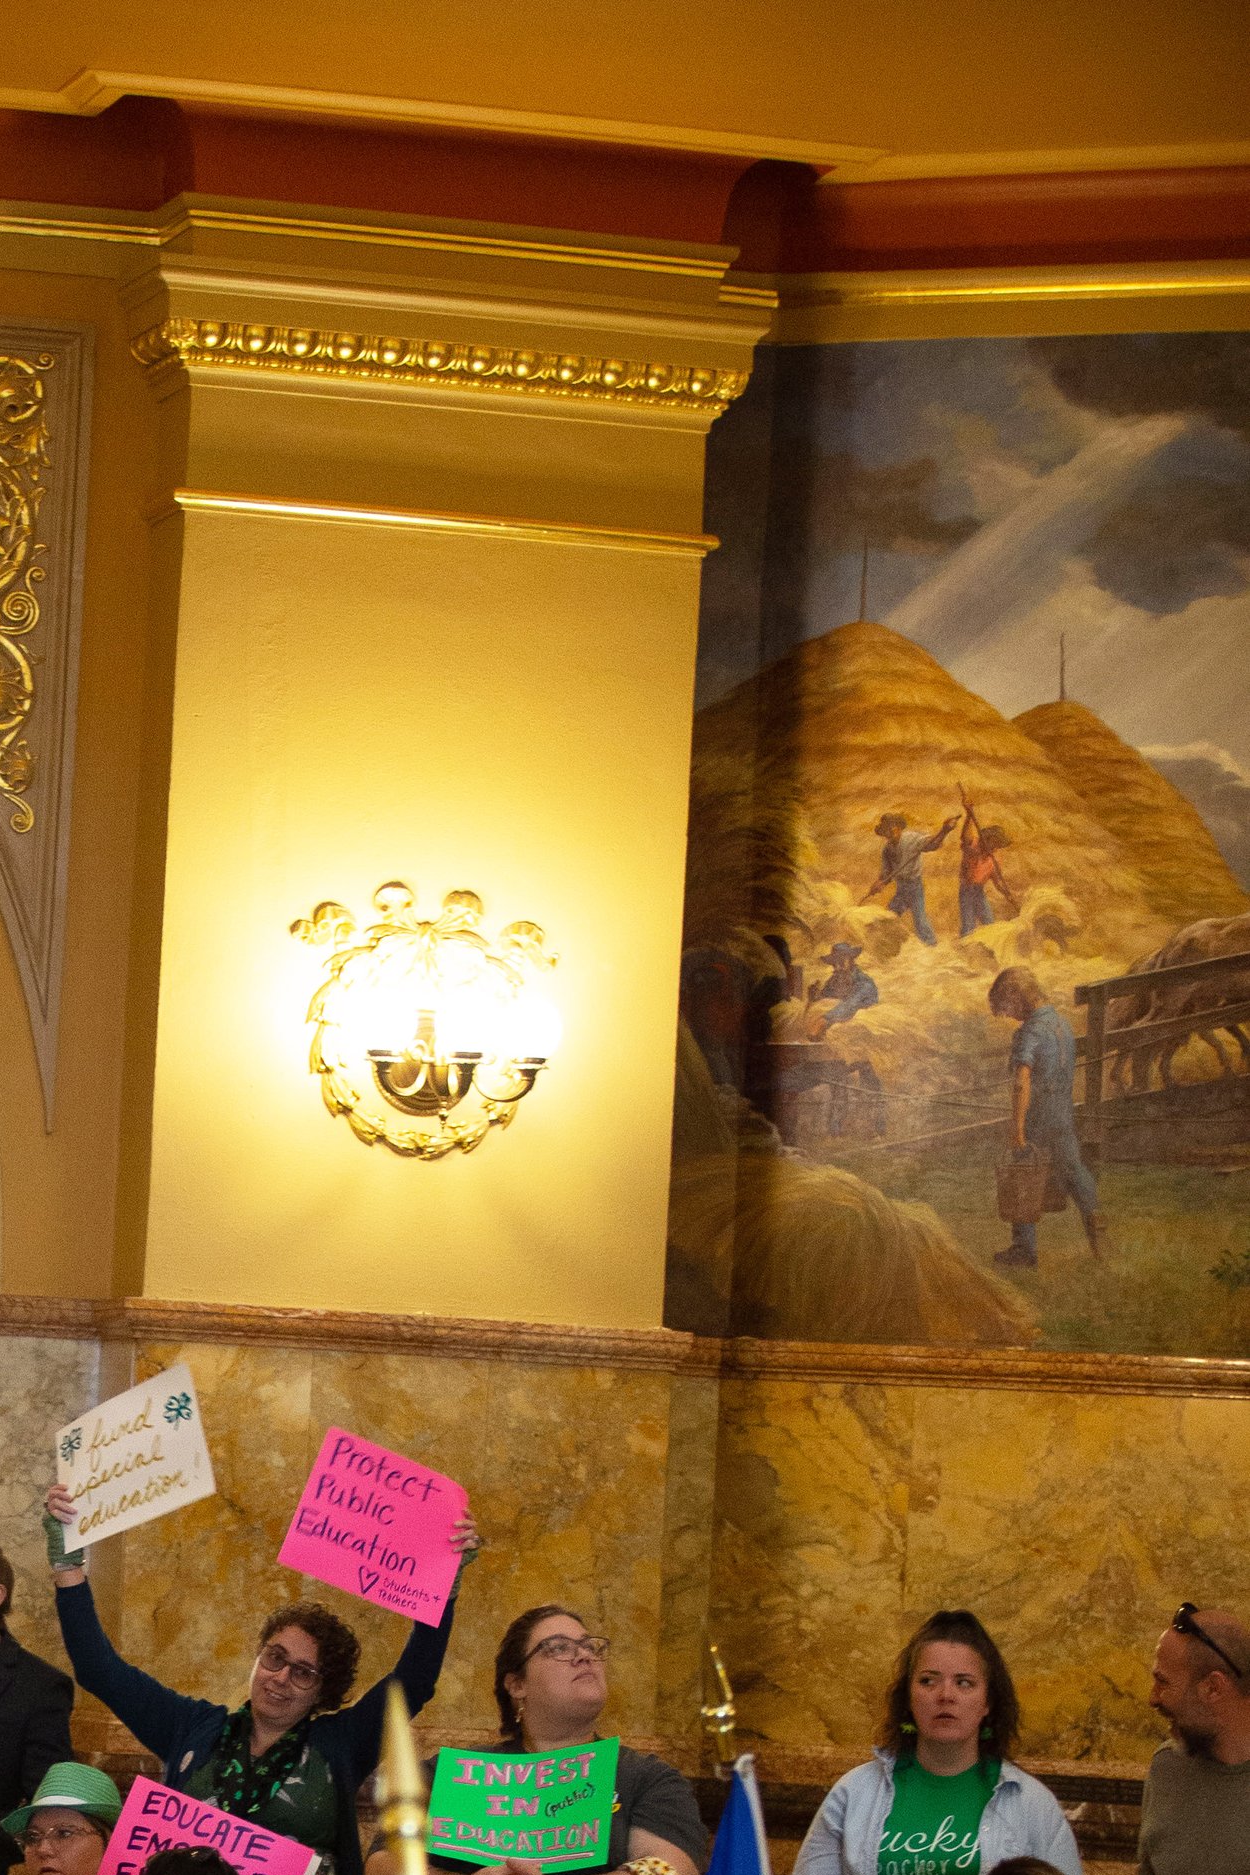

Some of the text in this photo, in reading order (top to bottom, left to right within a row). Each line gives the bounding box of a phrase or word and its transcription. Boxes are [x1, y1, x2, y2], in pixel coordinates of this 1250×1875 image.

[86, 1395, 155, 1473] fund
[70, 1434, 165, 1504] special
[329, 1436, 442, 1502] Protect
[315, 1473, 395, 1526] Public
[295, 1507, 417, 1576] Education
[452, 1751, 596, 1790] INVEST
[485, 1782, 597, 1819] IN (public)
[141, 1790, 276, 1863] EDUCATE
[431, 1817, 600, 1853] EDUCATION
[878, 1815, 981, 1869] ucky
